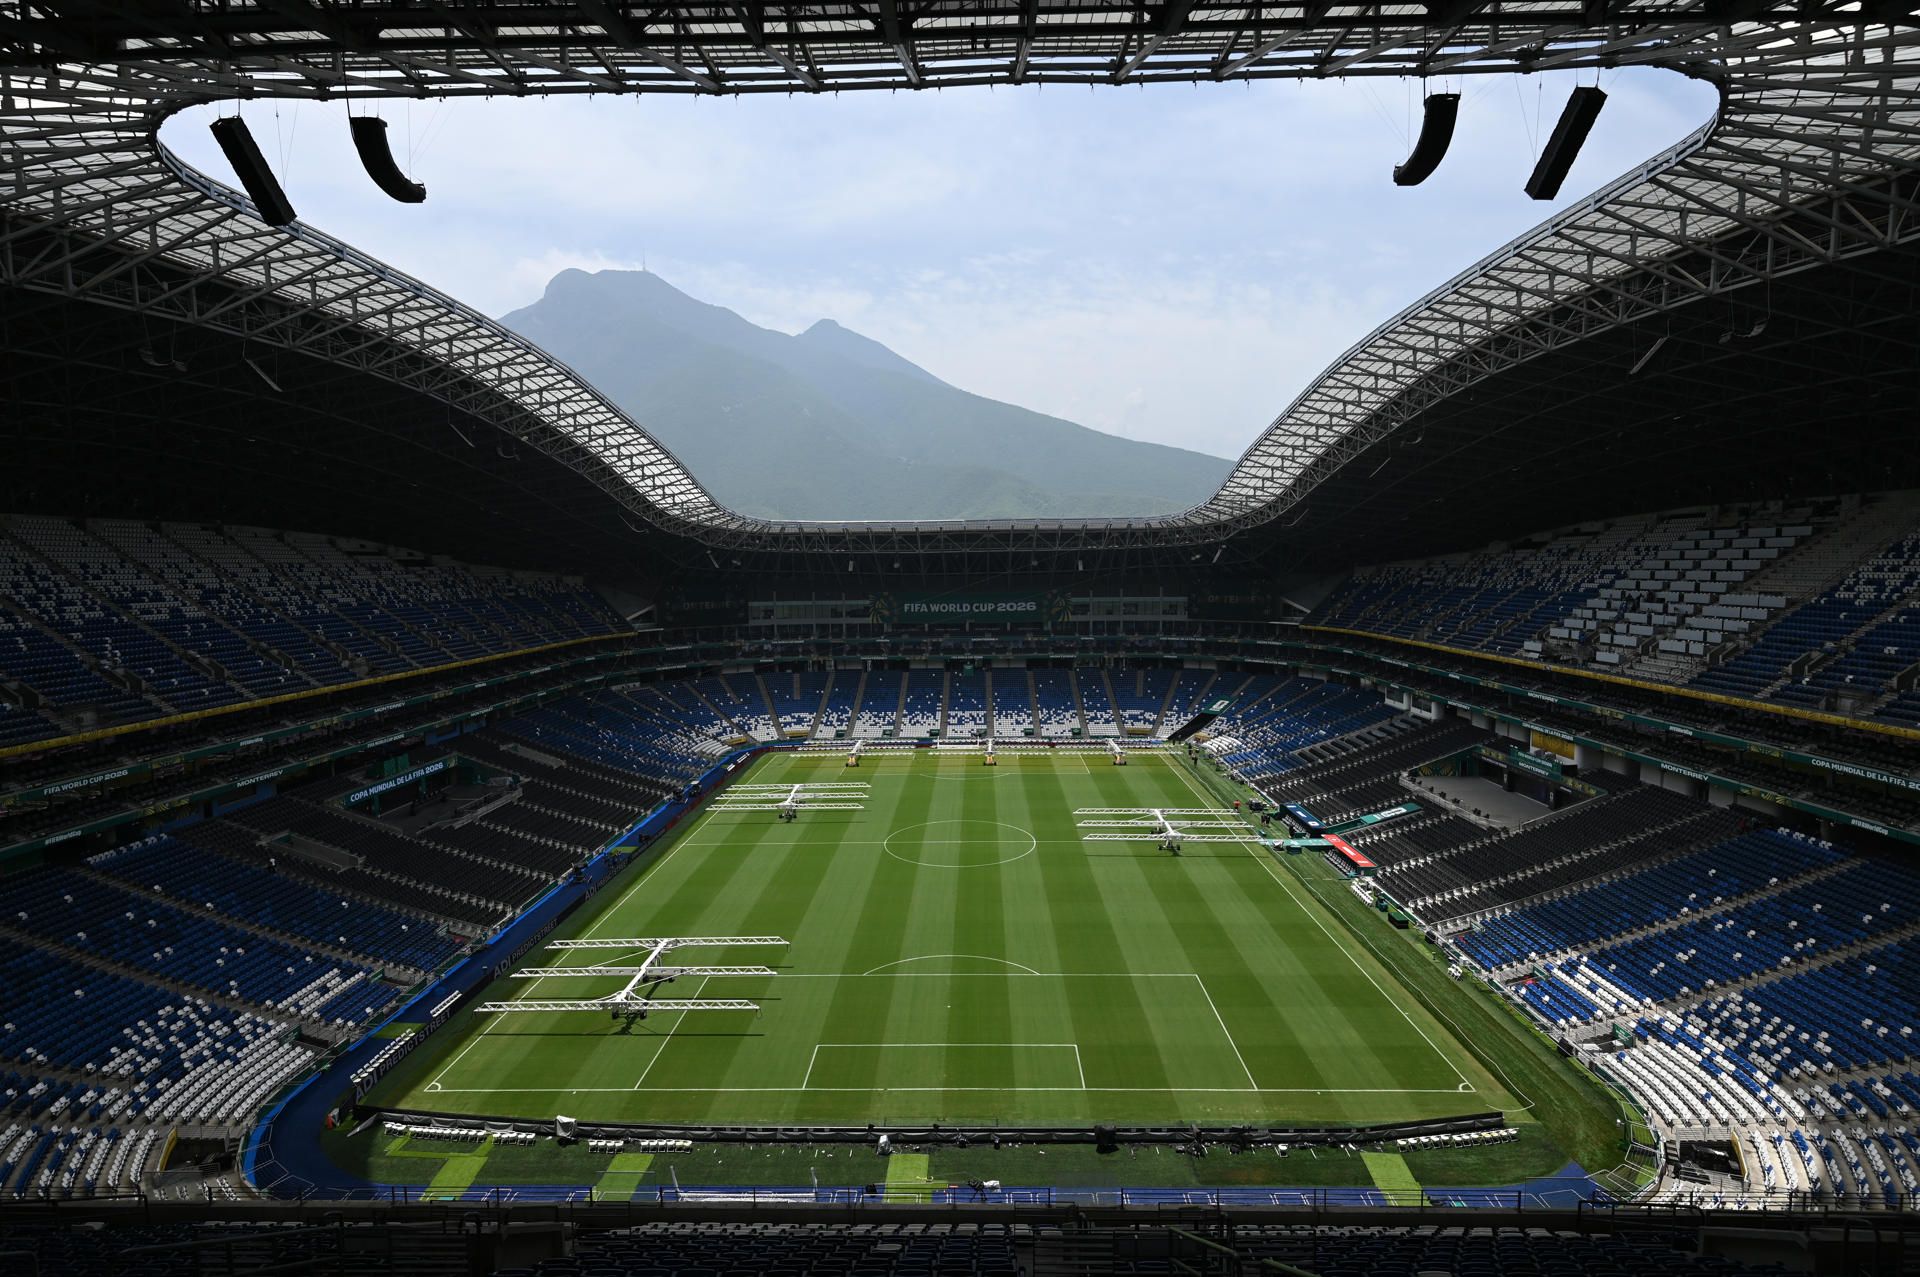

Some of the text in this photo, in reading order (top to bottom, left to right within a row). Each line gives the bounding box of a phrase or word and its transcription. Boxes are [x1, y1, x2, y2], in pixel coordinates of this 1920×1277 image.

[904, 601, 1037, 613] FIFA WORLD CUP 2026
[43, 769, 128, 796] FIFA WORLD CUP 2026
[350, 762, 443, 802] COPA MUNDIAL DE LA FIFA 2026
[1661, 763, 1708, 781] MONTERREY
[1811, 758, 1830, 769] COPA
[1831, 763, 1865, 777] MUNDIAL
[1866, 771, 1877, 780] DE
[1877, 774, 1888, 783] LA
[1888, 776, 1906, 787] FIFA
[494, 955, 512, 979] ADI
[355, 1009, 454, 1105] ADI PREDICTSTREET
